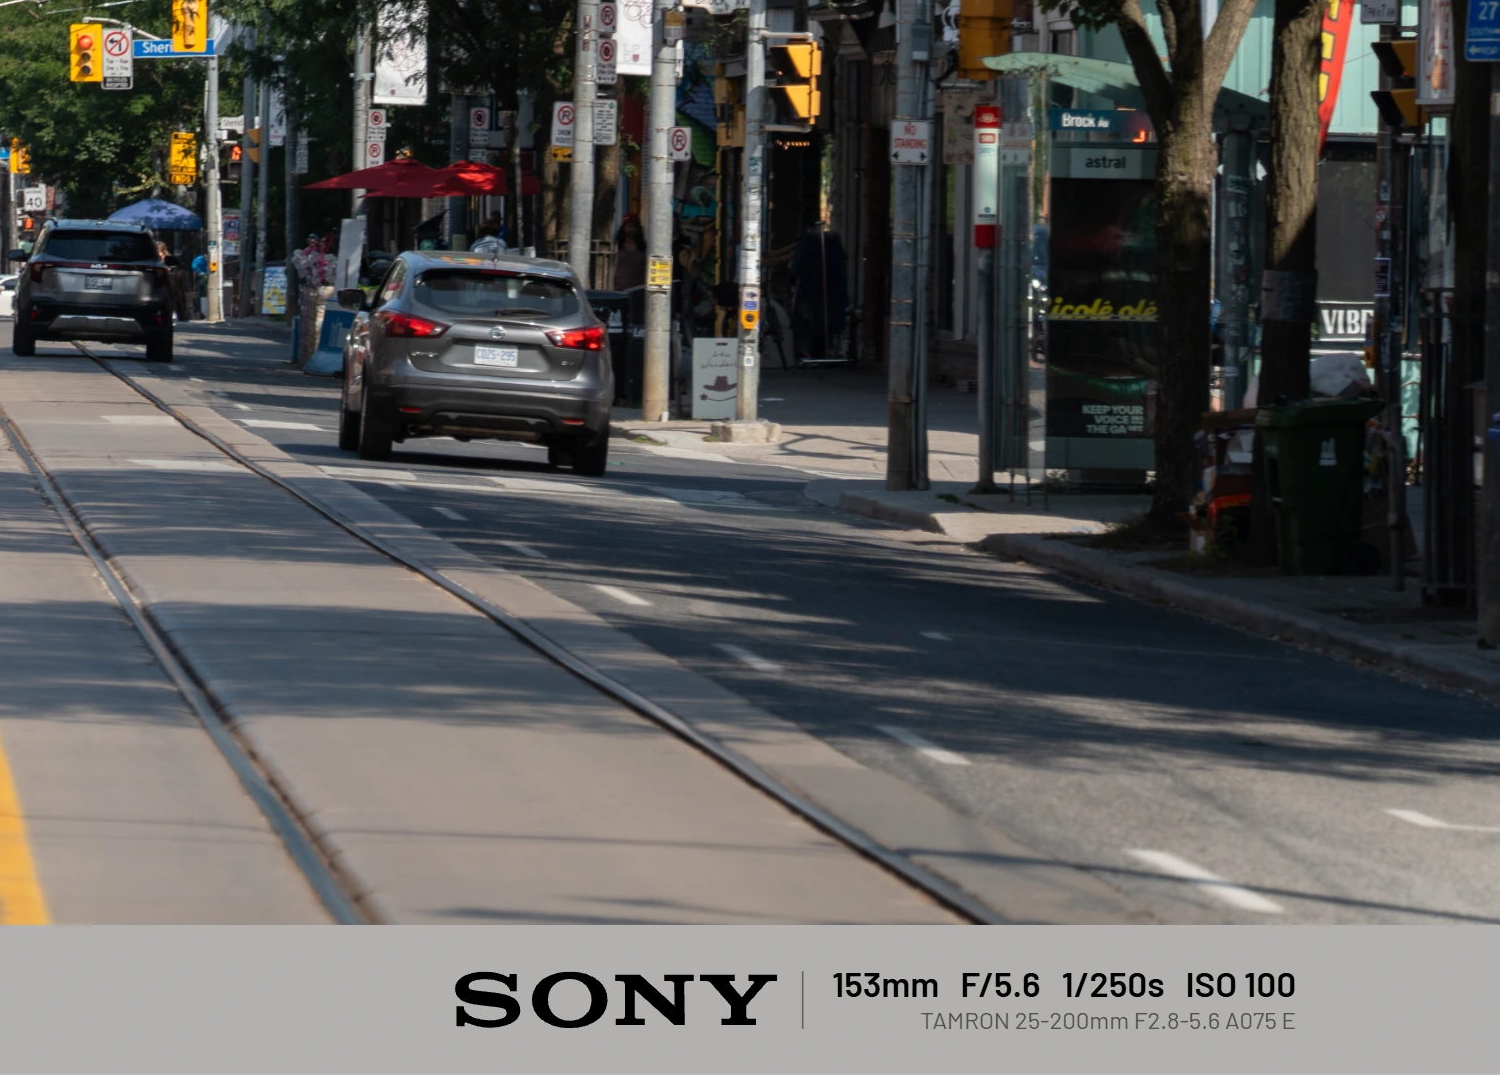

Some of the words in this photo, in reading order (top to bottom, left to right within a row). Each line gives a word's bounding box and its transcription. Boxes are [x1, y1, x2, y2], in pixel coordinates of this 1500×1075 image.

[1061, 112, 1096, 128] Brock
[903, 125, 917, 136] NO
[894, 137, 927, 149] STANDING
[1084, 155, 1127, 169] astral
[26, 197, 43, 209] 40
[1046, 297, 1113, 320] icolé
[1082, 405, 1111, 414] KEEP
[1112, 405, 1144, 414] YOUR
[1094, 415, 1130, 424] VOICE
[1086, 424, 1109, 434] THE
